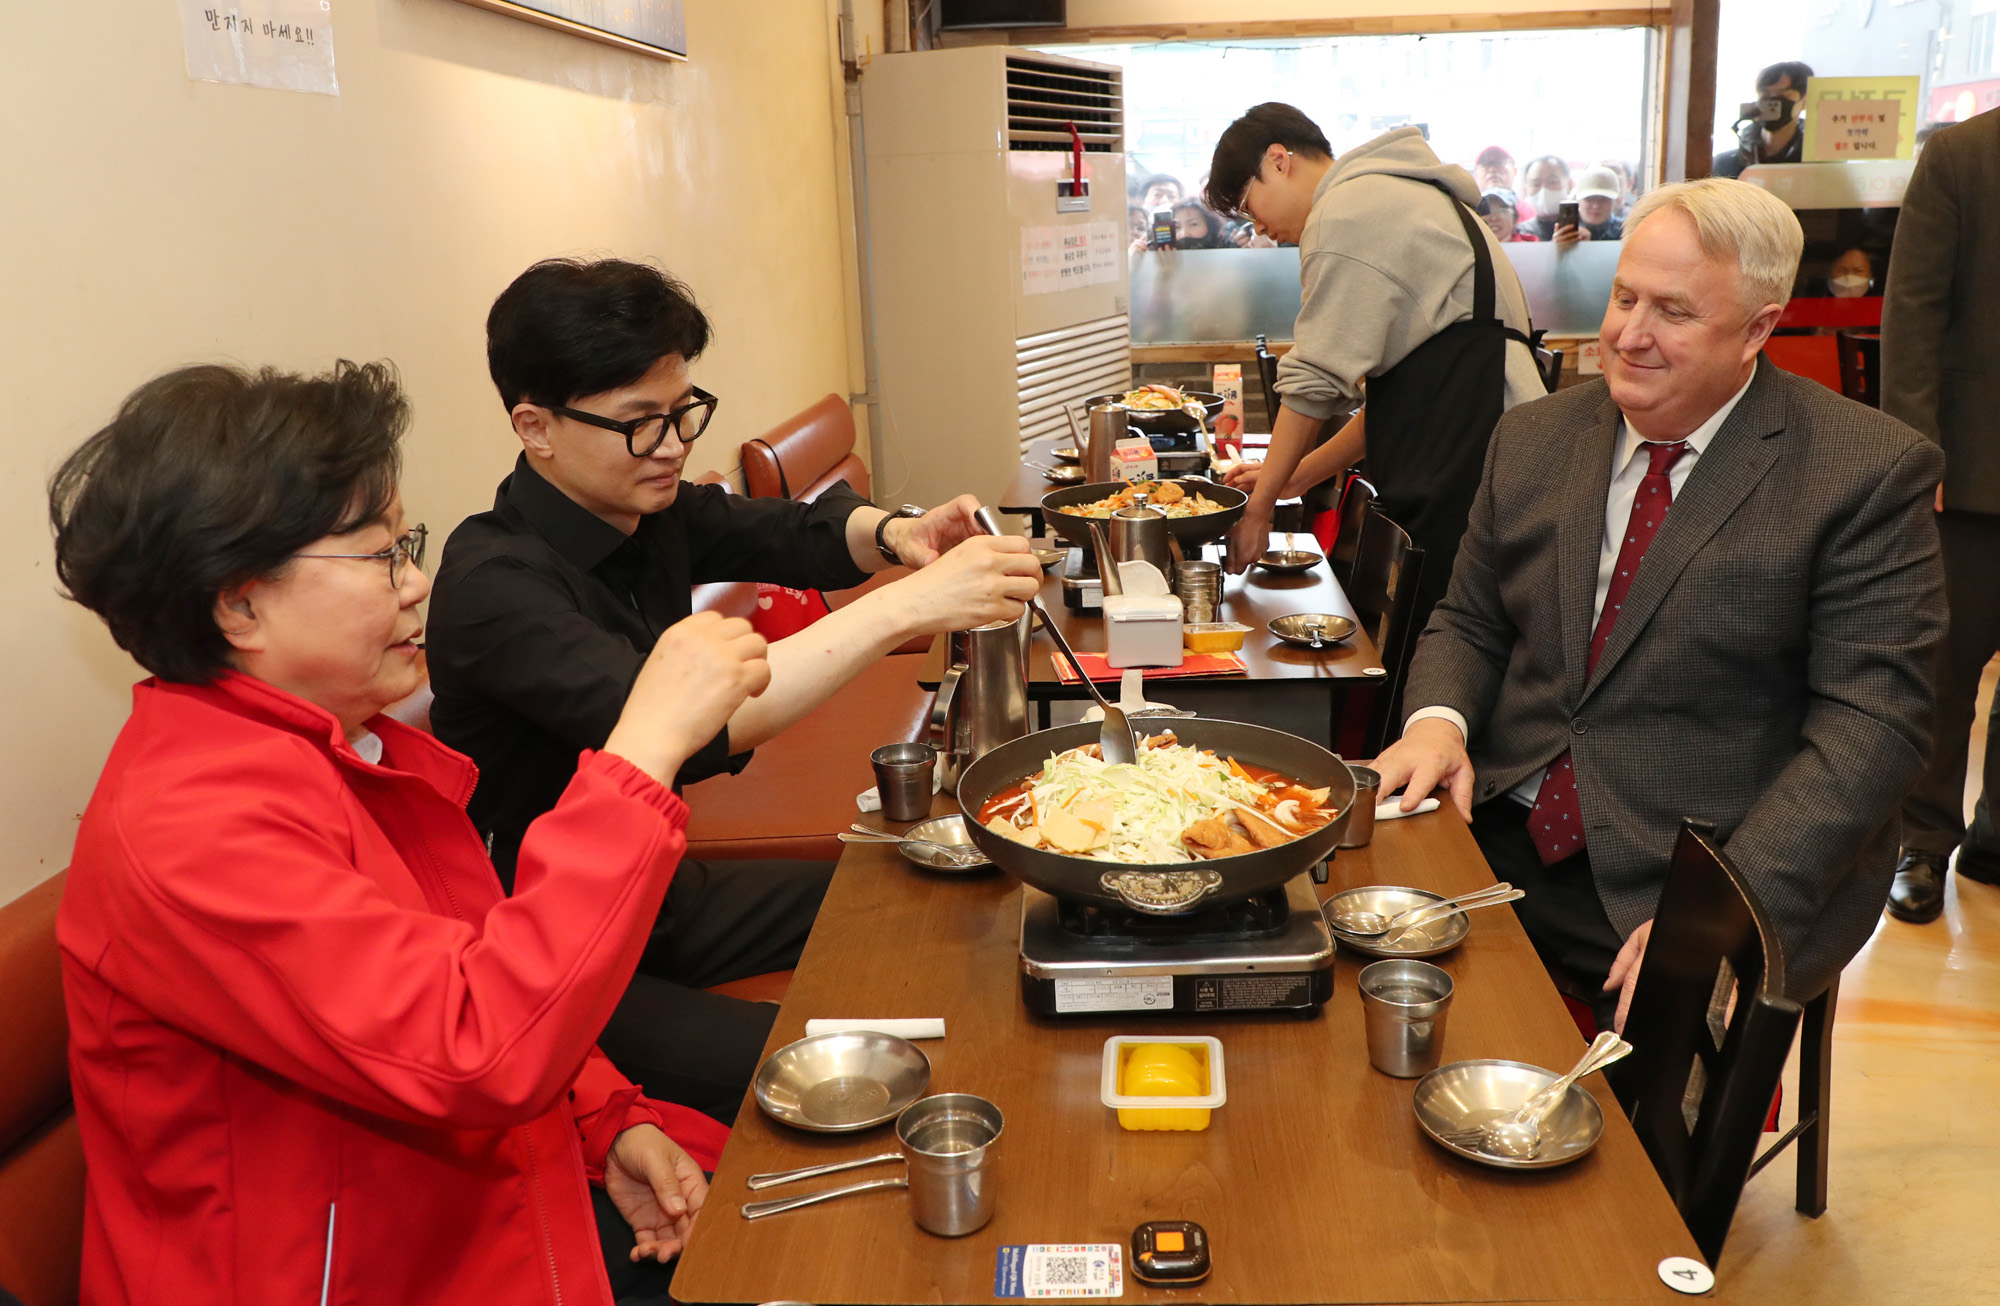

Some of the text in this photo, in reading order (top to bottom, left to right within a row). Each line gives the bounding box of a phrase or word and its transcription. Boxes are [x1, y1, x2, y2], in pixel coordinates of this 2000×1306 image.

[204, 9, 315, 46] 만지지 마세요!!
[1672, 1269, 1698, 1281] 4
